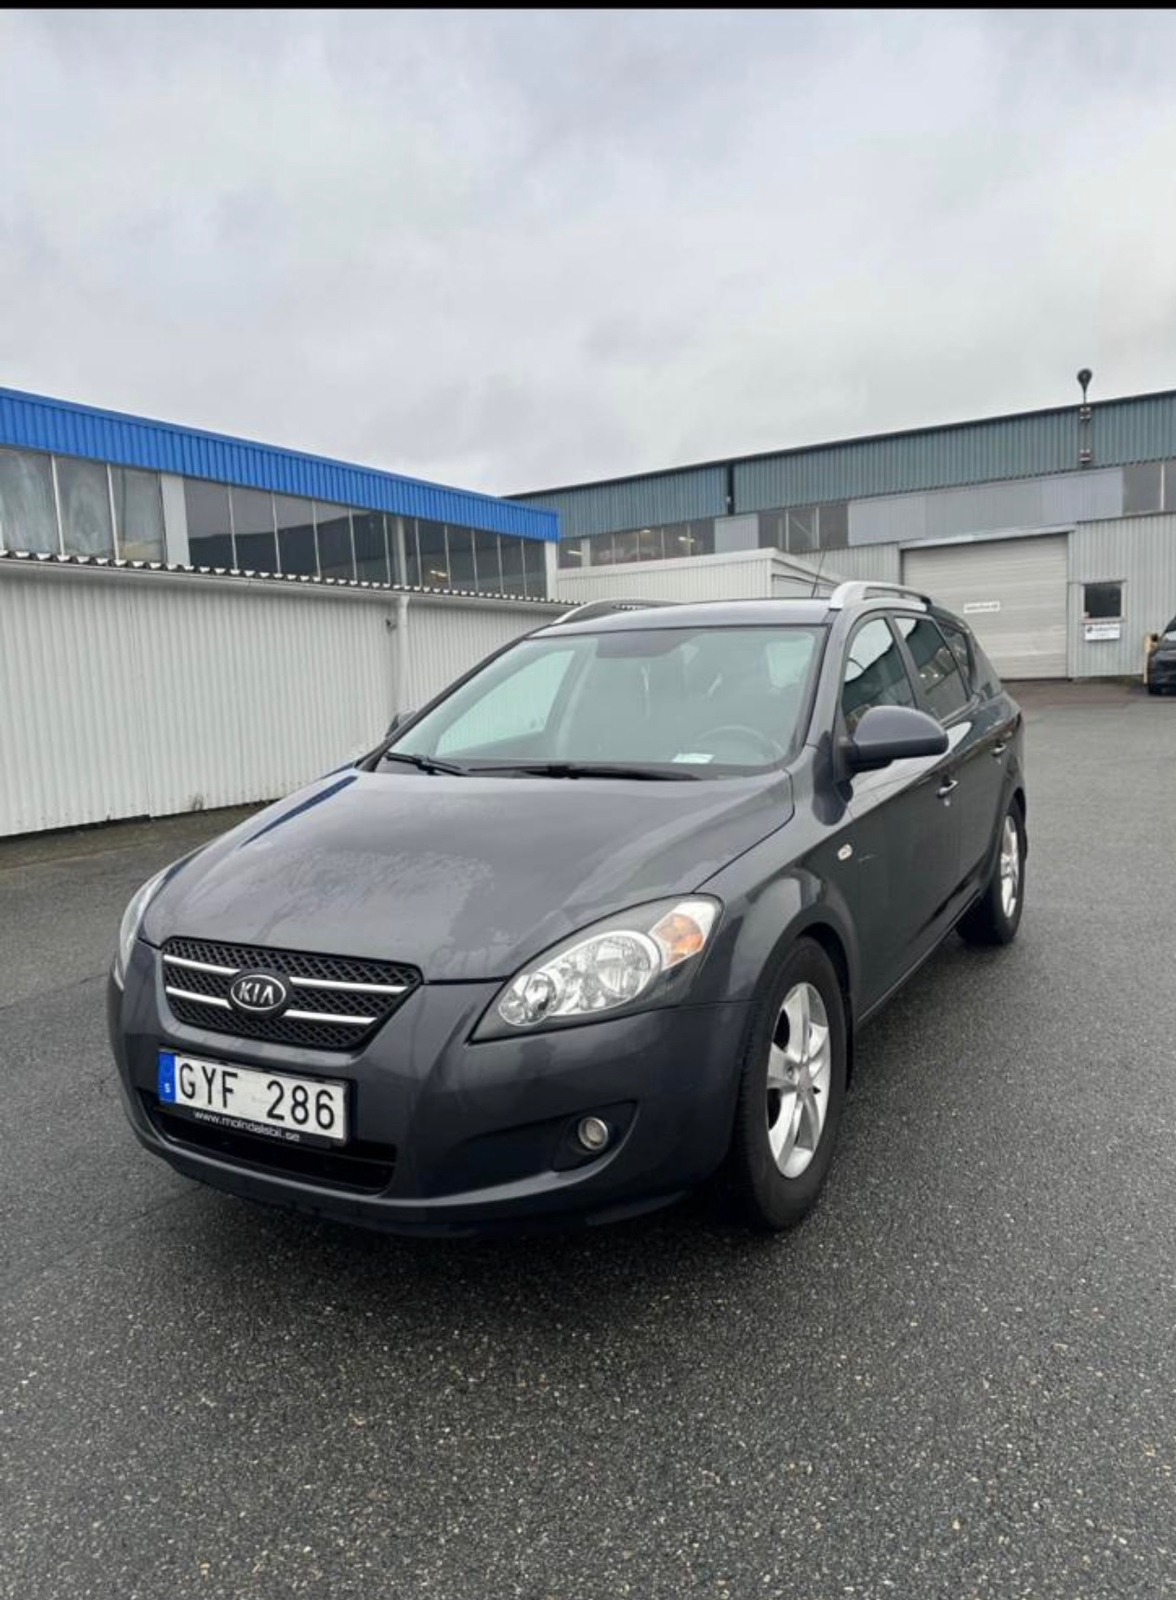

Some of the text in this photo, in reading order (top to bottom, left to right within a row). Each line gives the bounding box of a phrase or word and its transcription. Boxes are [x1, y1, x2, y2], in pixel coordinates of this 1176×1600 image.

[239, 981, 274, 1006] KIA
[179, 1062, 335, 1131] GYF 286
